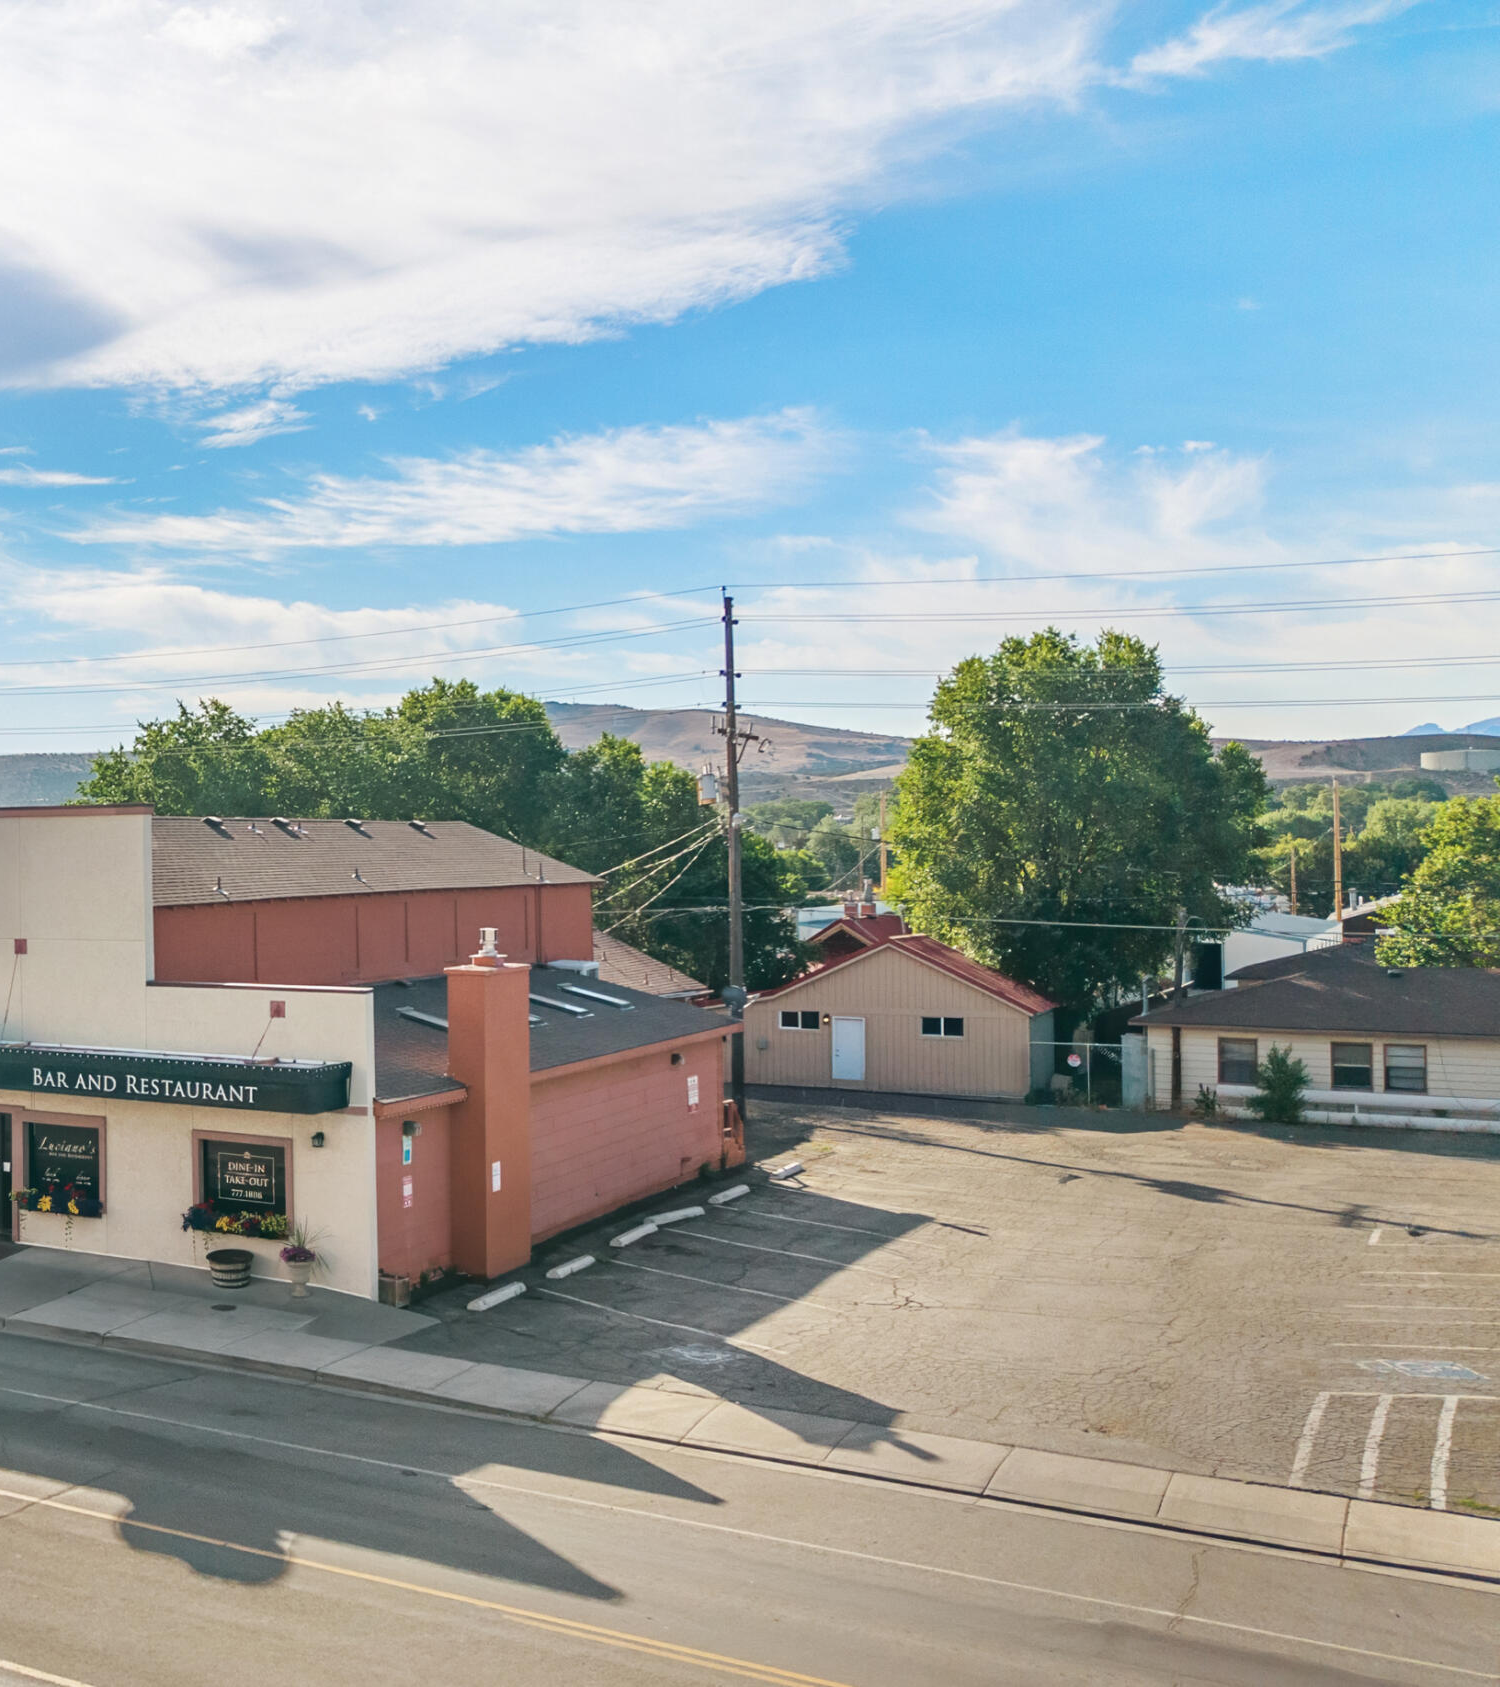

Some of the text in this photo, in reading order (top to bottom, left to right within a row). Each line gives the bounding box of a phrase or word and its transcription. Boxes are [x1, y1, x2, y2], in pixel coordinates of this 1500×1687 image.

[32, 1067, 259, 1104] BAR AND RESTAURANT
[38, 1136, 96, 1154] Luciano's
[227, 1161, 266, 1173] DINE-IN
[224, 1174, 269, 1188] TAKE-OUT
